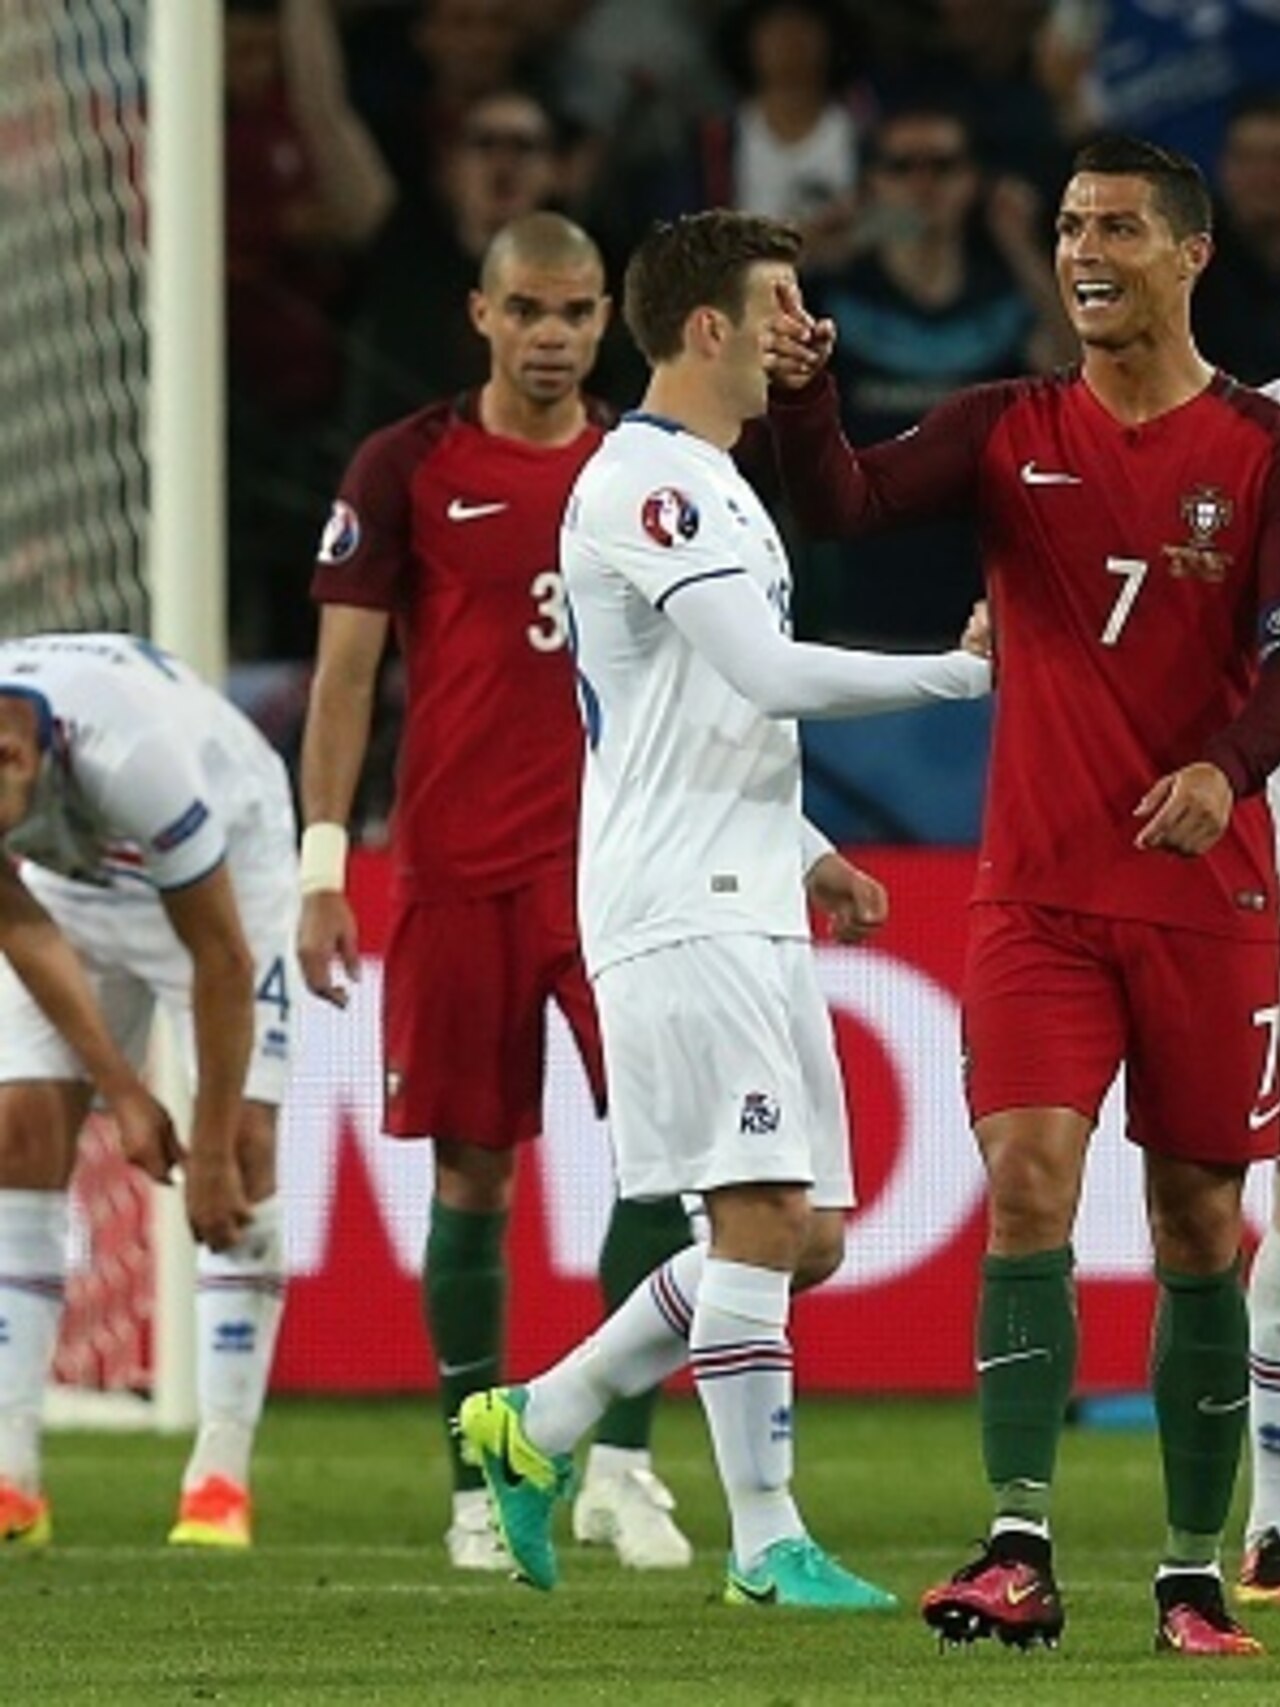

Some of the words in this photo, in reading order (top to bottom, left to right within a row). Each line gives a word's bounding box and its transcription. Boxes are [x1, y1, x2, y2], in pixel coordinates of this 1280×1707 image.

[526, 572, 567, 652] 3
[1101, 556, 1149, 645] 7
[1253, 1006, 1280, 1098] 7
